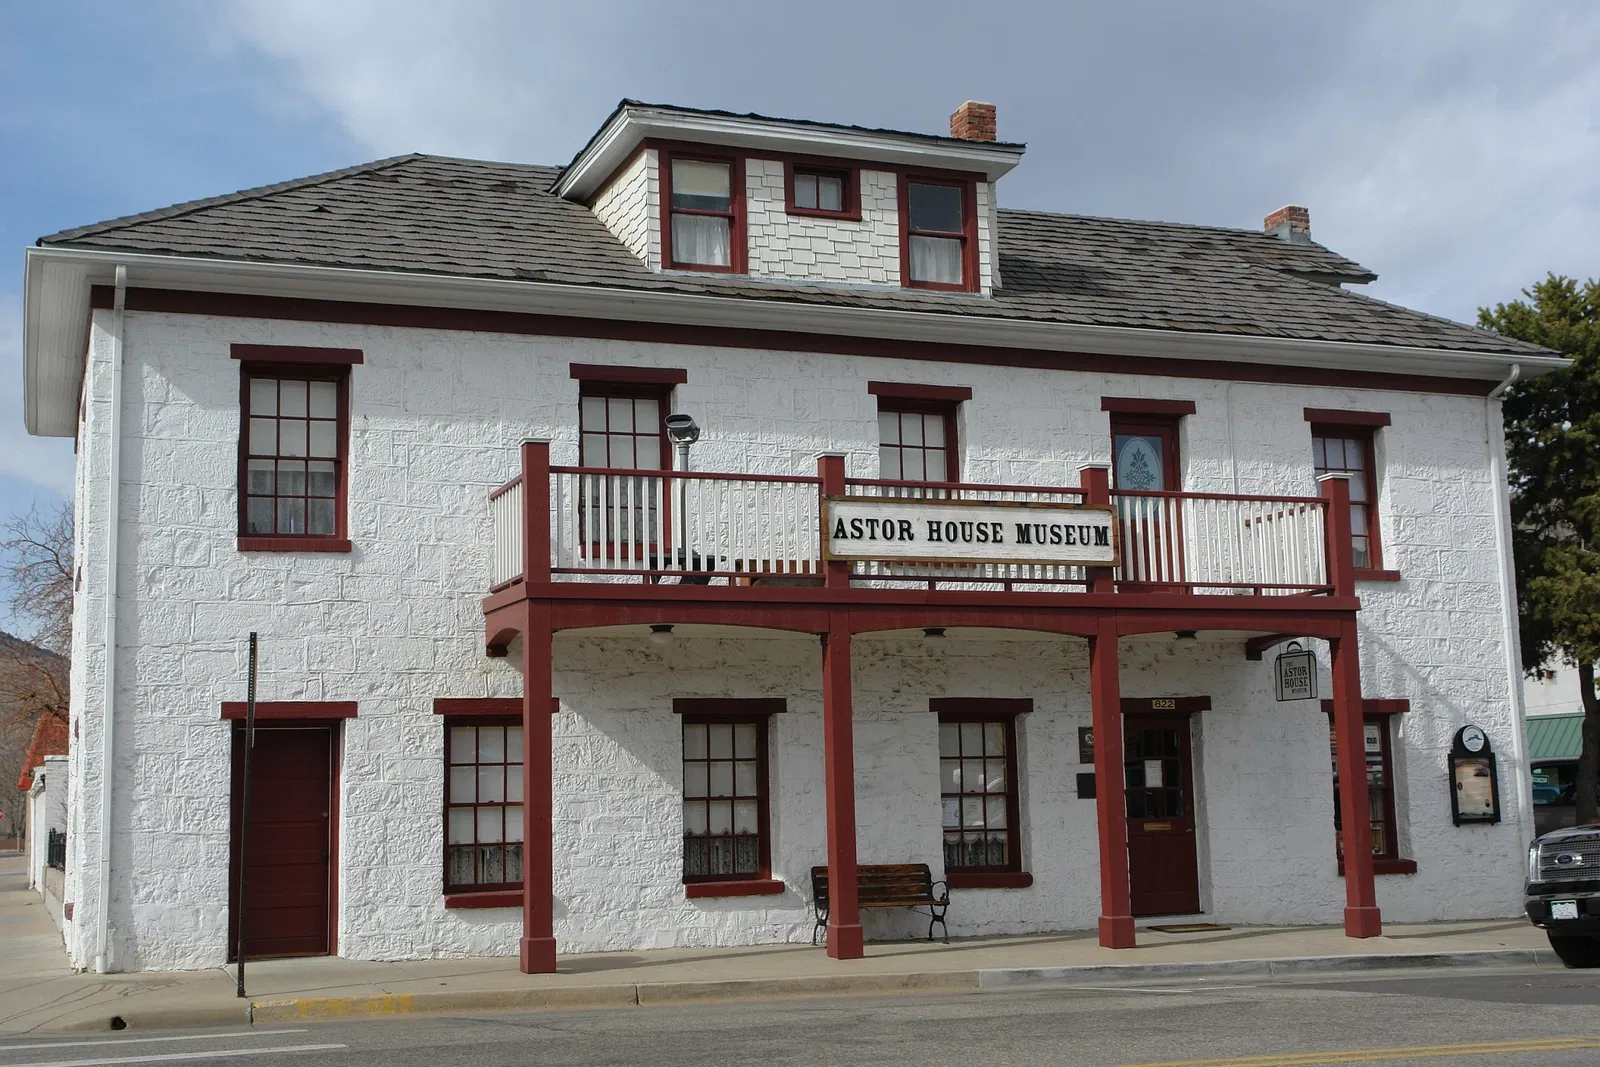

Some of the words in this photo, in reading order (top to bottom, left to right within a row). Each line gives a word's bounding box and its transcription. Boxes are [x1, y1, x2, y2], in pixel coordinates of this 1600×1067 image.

[833, 517, 915, 541] ASTOR
[927, 520, 1004, 543] HOUSE
[1015, 523, 1110, 547] MUSEUM
[1284, 666, 1307, 678] ASTOR
[1284, 677, 1308, 688] HOUSE
[1155, 700, 1174, 708] 822
